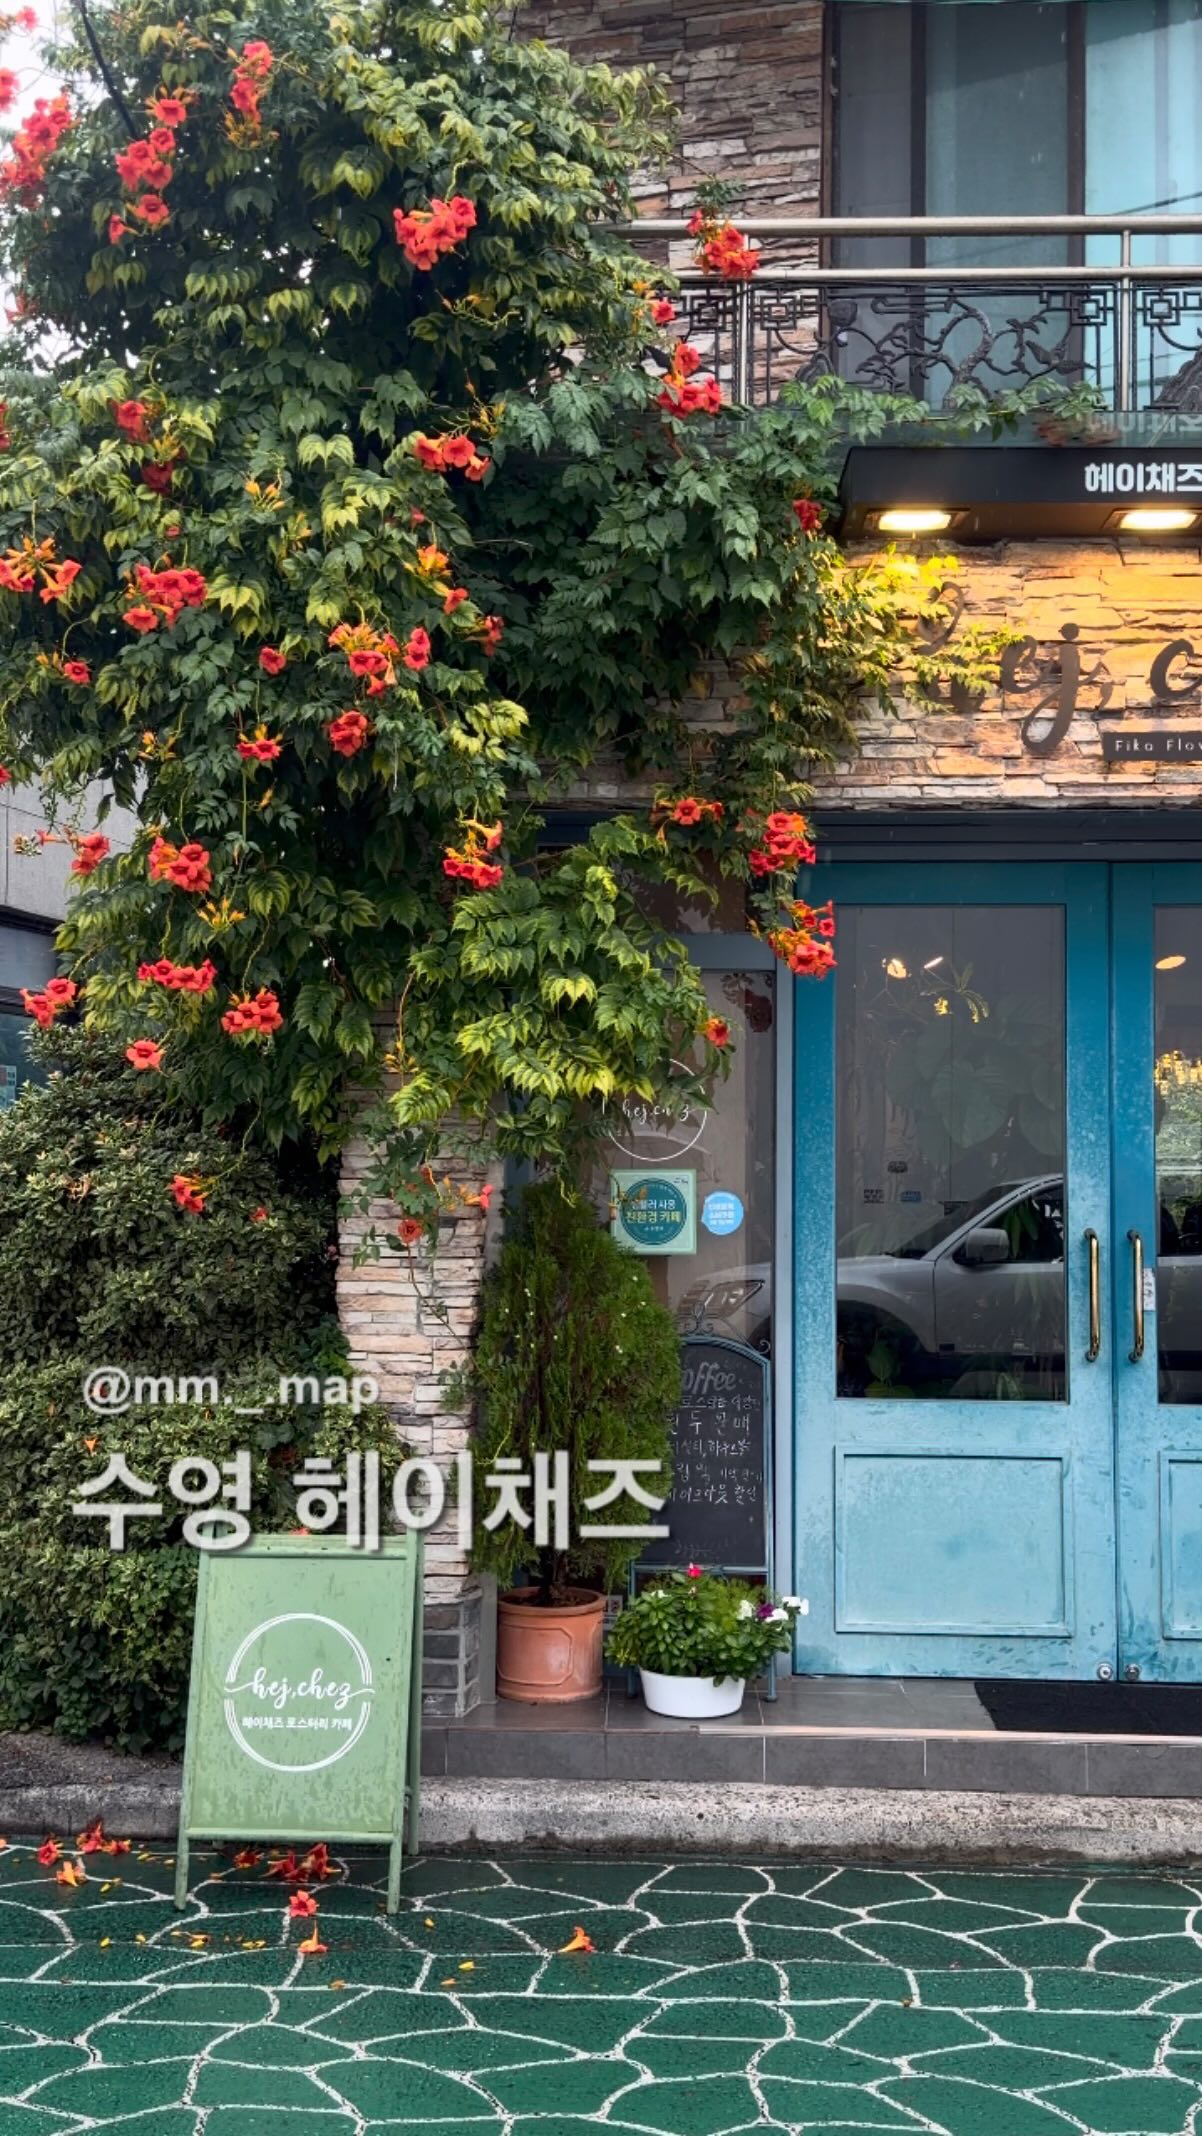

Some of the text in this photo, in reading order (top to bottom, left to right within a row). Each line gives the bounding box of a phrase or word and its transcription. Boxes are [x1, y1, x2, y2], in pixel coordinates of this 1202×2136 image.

[1115, 738, 1153, 752] Fika
[681, 1361, 736, 1395] offee
[224, 1667, 375, 1710] hej,chez
[286, 1717, 329, 1730] 로스터리
[331, 1717, 352, 1731] 카페
